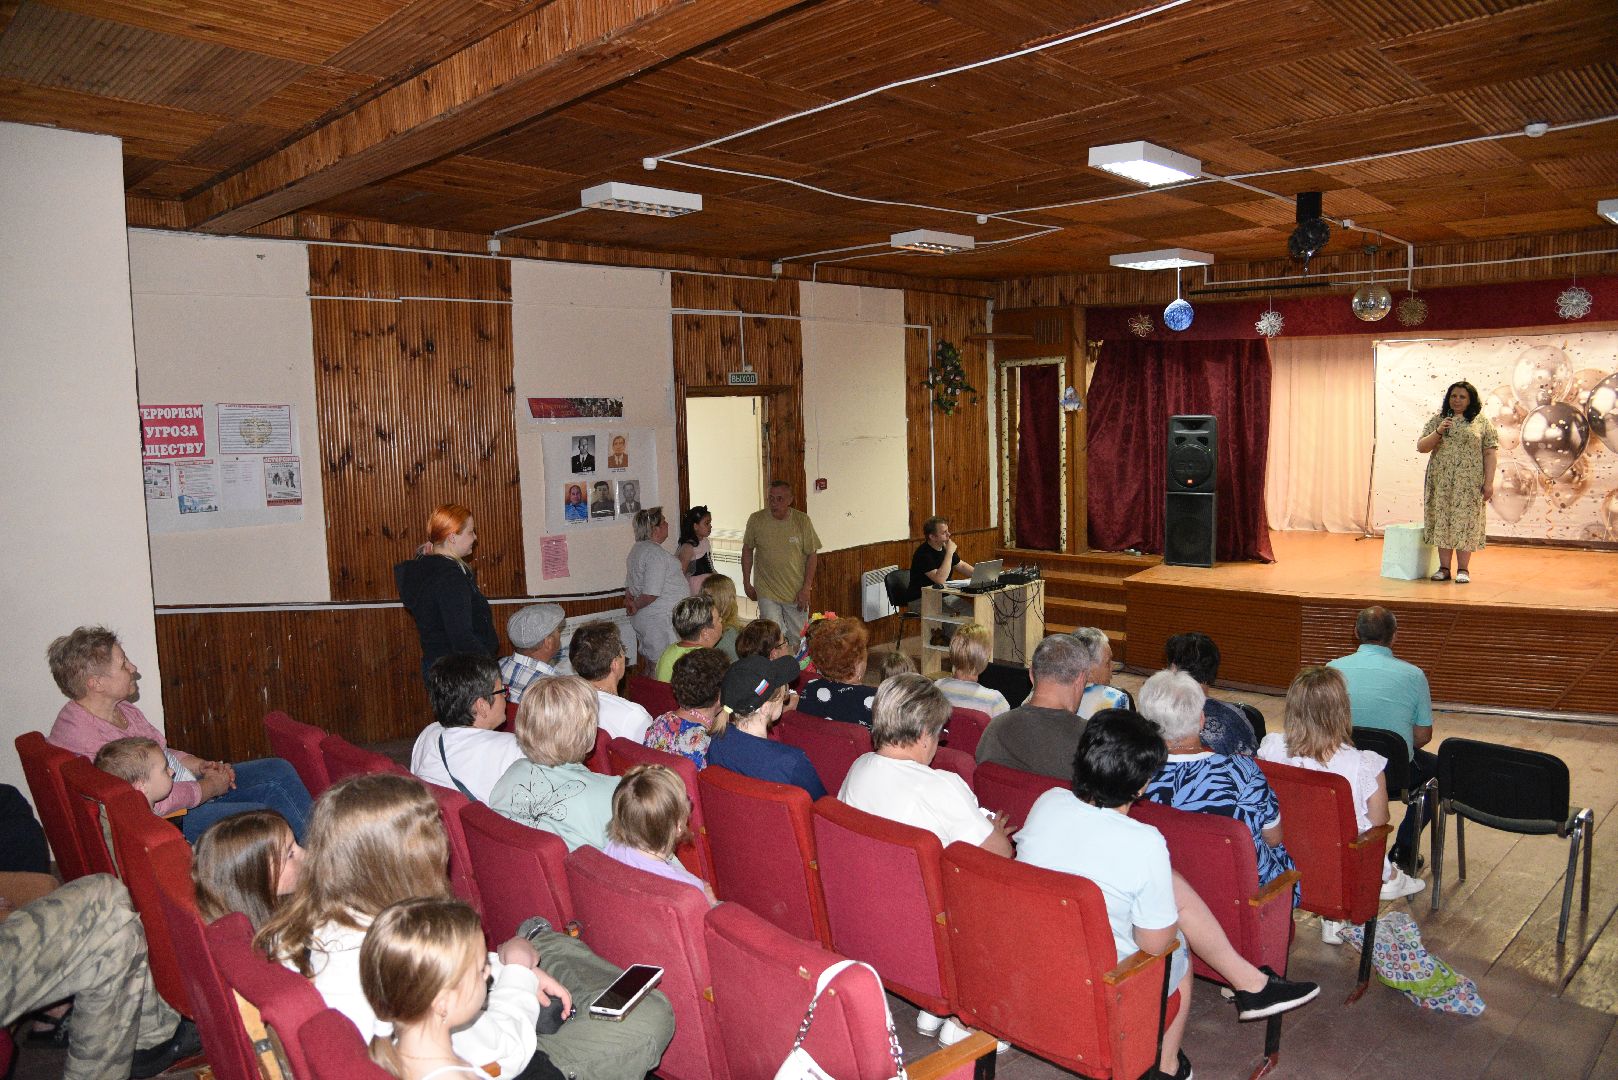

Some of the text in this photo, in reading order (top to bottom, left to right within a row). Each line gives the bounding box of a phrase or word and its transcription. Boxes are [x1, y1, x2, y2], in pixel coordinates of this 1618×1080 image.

[731, 375, 755, 383] ВЫХОД
[145, 425, 198, 438] УГРОЗА
[142, 443, 203, 457] ЩЕСТВУ
